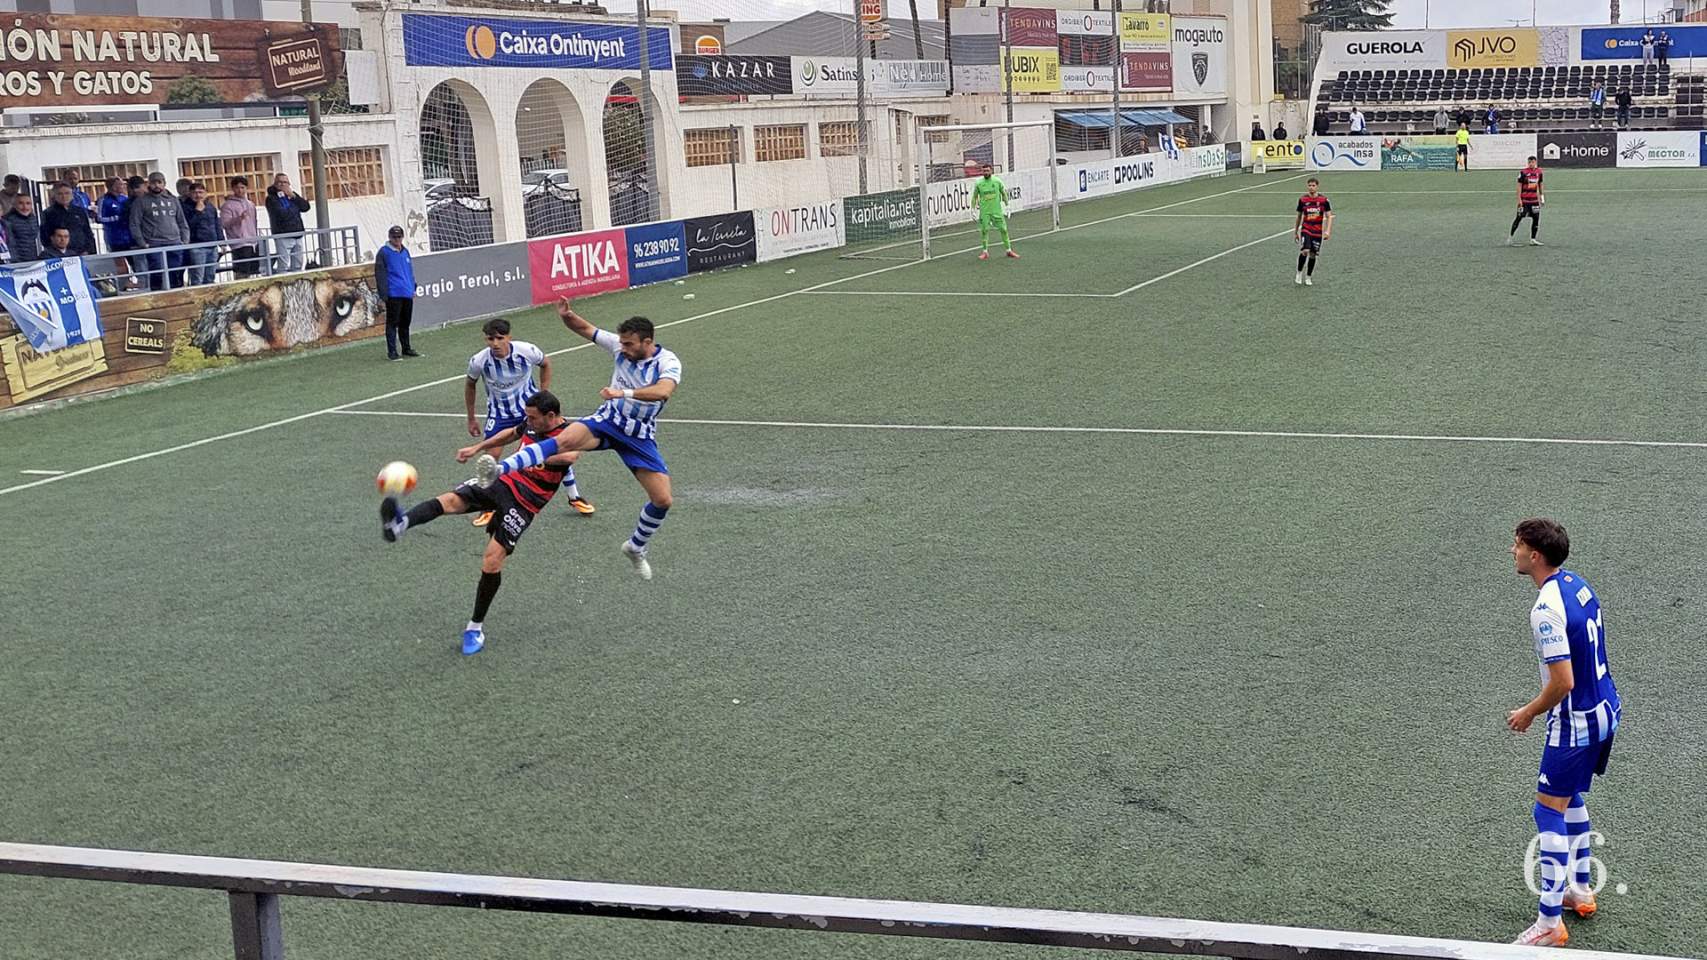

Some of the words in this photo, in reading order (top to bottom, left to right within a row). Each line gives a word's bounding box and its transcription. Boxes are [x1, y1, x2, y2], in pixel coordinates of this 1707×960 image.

[861, 5, 880, 14] ING
[1009, 18, 1056, 29] TENDAVINS
[1175, 26, 1224, 46] mogauto
[1618, 39, 1639, 47] Caixa
[72, 30, 219, 62] NATURAL
[500, 30, 547, 54] Caixa
[550, 34, 625, 61] Ontinyent
[1346, 41, 1424, 55] GUEROLA
[1478, 36, 1516, 54] JVO
[272, 47, 320, 66] NATURAL
[711, 61, 775, 78] KAZAR
[1129, 61, 1169, 71] TENDAVINS
[47, 71, 64, 95] Y
[73, 71, 153, 95] GATOS
[1338, 140, 1373, 148] acabados
[1353, 149, 1374, 158] insa
[1391, 154, 1414, 163] RAFA
[1088, 169, 1110, 184] ENCARTE
[1121, 161, 1154, 184] POOLINS
[771, 203, 836, 237] ONTRANS
[851, 197, 916, 228] kapitalia.net
[634, 243, 644, 258] 96
[643, 241, 659, 257] 238
[659, 239, 670, 254] 90
[669, 237, 680, 252] 92
[551, 240, 620, 279] ATIKA
[700, 251, 746, 264] RESTAURANT
[415, 278, 454, 298] ergio
[459, 270, 500, 289] Terol,
[504, 266, 525, 282] s.l.
[139, 323, 154, 333] NO
[128, 335, 164, 348] CEREALS
